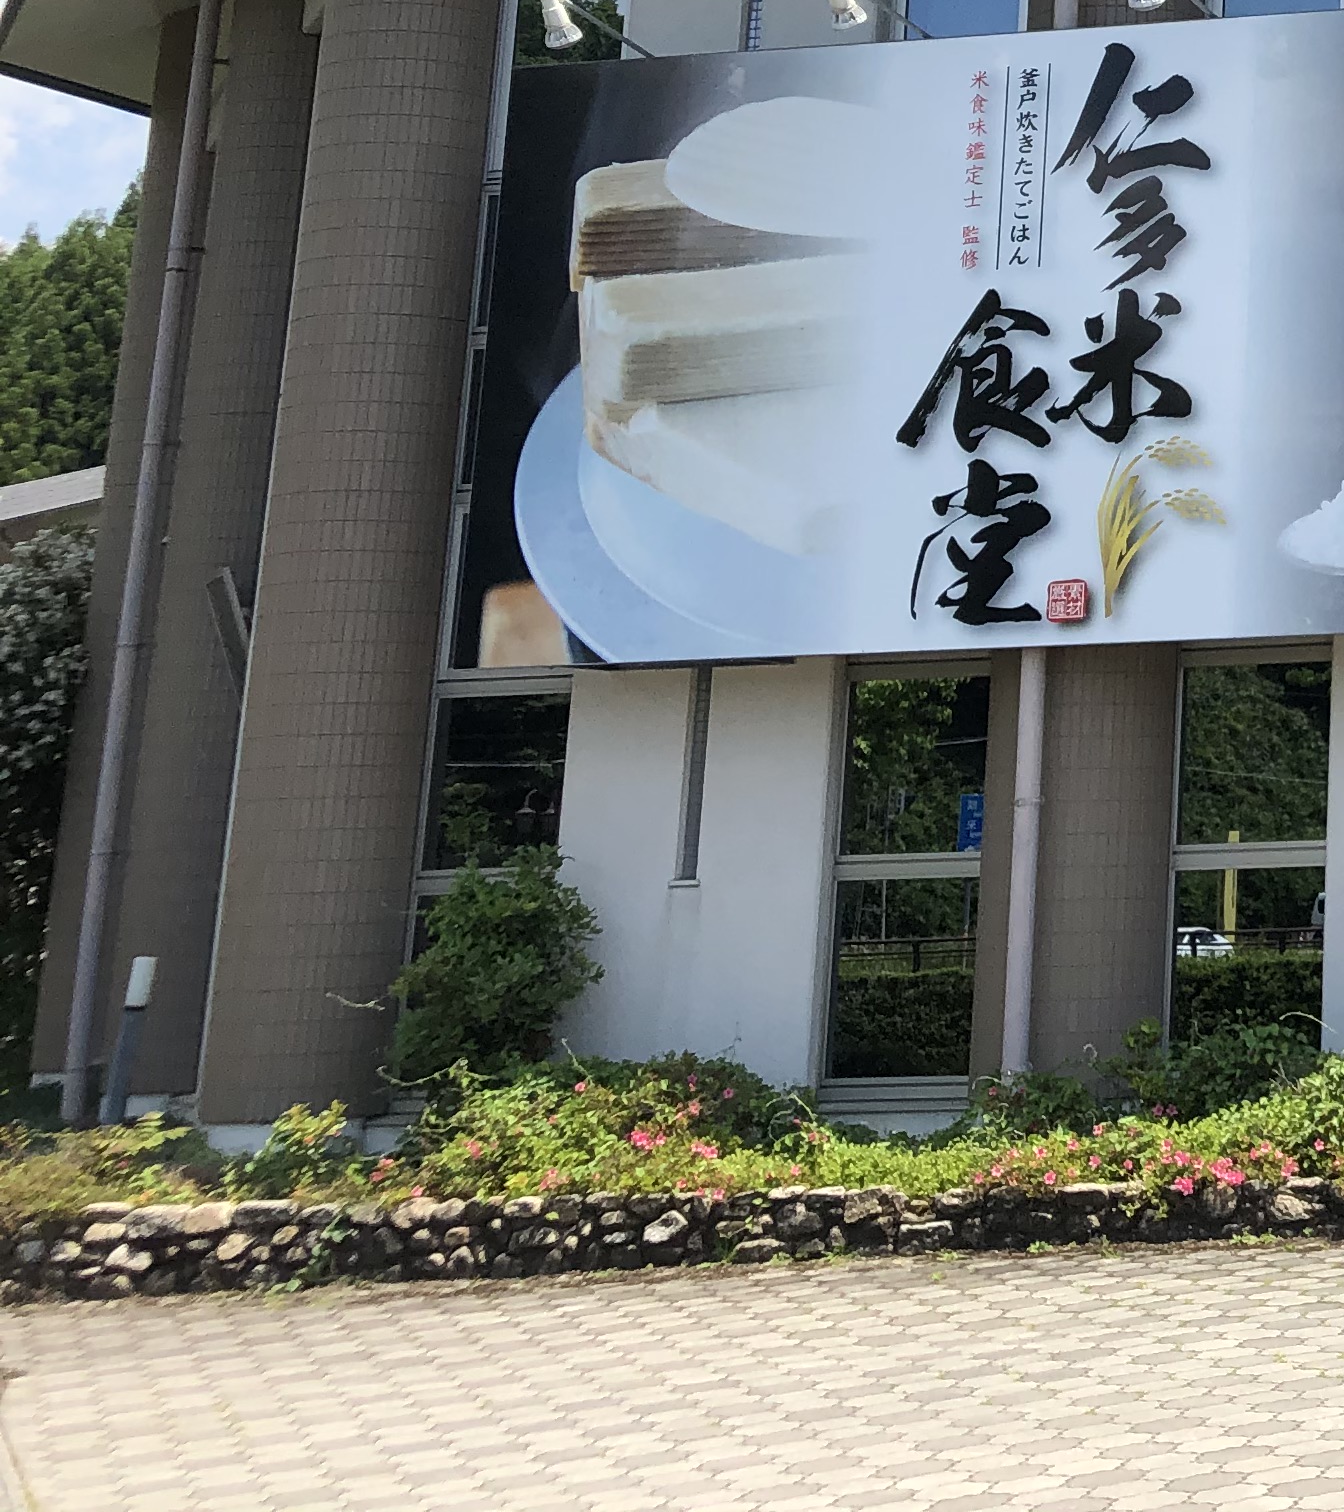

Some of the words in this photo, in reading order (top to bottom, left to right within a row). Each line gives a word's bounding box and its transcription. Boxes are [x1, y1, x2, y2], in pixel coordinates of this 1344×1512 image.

[963, 70, 989, 208] 米食味鑑定士
[1008, 67, 1040, 266] 釜戸炊きたてごはん
[960, 225, 980, 271] 監修
[1045, 43, 1211, 444] 仁多米
[895, 289, 1052, 626] 食堂
